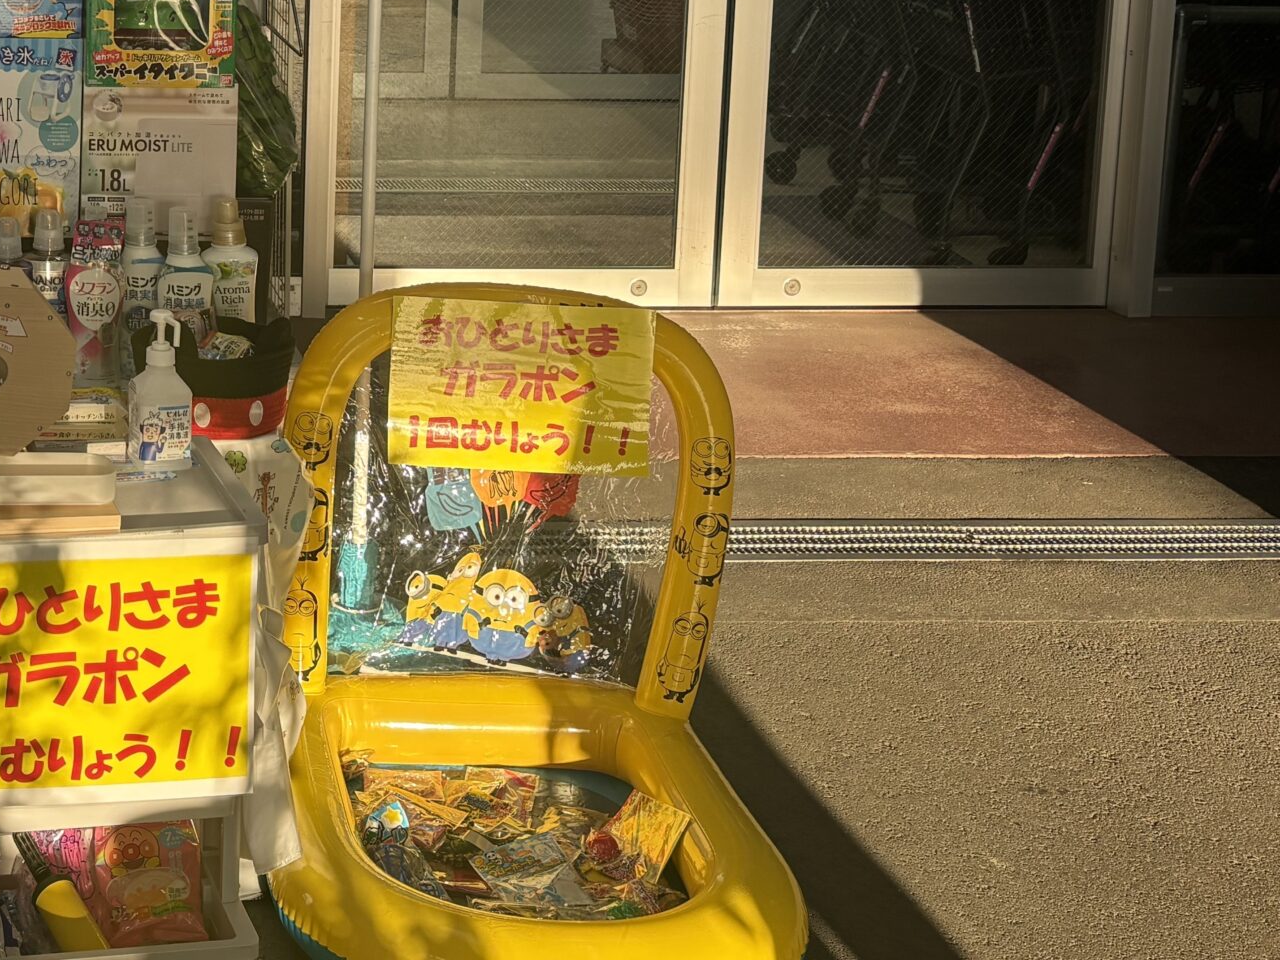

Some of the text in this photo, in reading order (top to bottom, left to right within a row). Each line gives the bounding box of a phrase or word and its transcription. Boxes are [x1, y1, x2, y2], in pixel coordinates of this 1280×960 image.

[88, 139, 193, 153] ERU MOIST LITE
[99, 169, 130, 192] 1.8L
[74, 280, 117, 295] ソフラン
[167, 283, 201, 296] ハミング
[214, 285, 250, 295] Aroma
[163, 298, 205, 309] 消臭実感
[221, 295, 245, 305] Rich
[419, 313, 619, 357] おひとりさま
[441, 362, 596, 403] ガラポン
